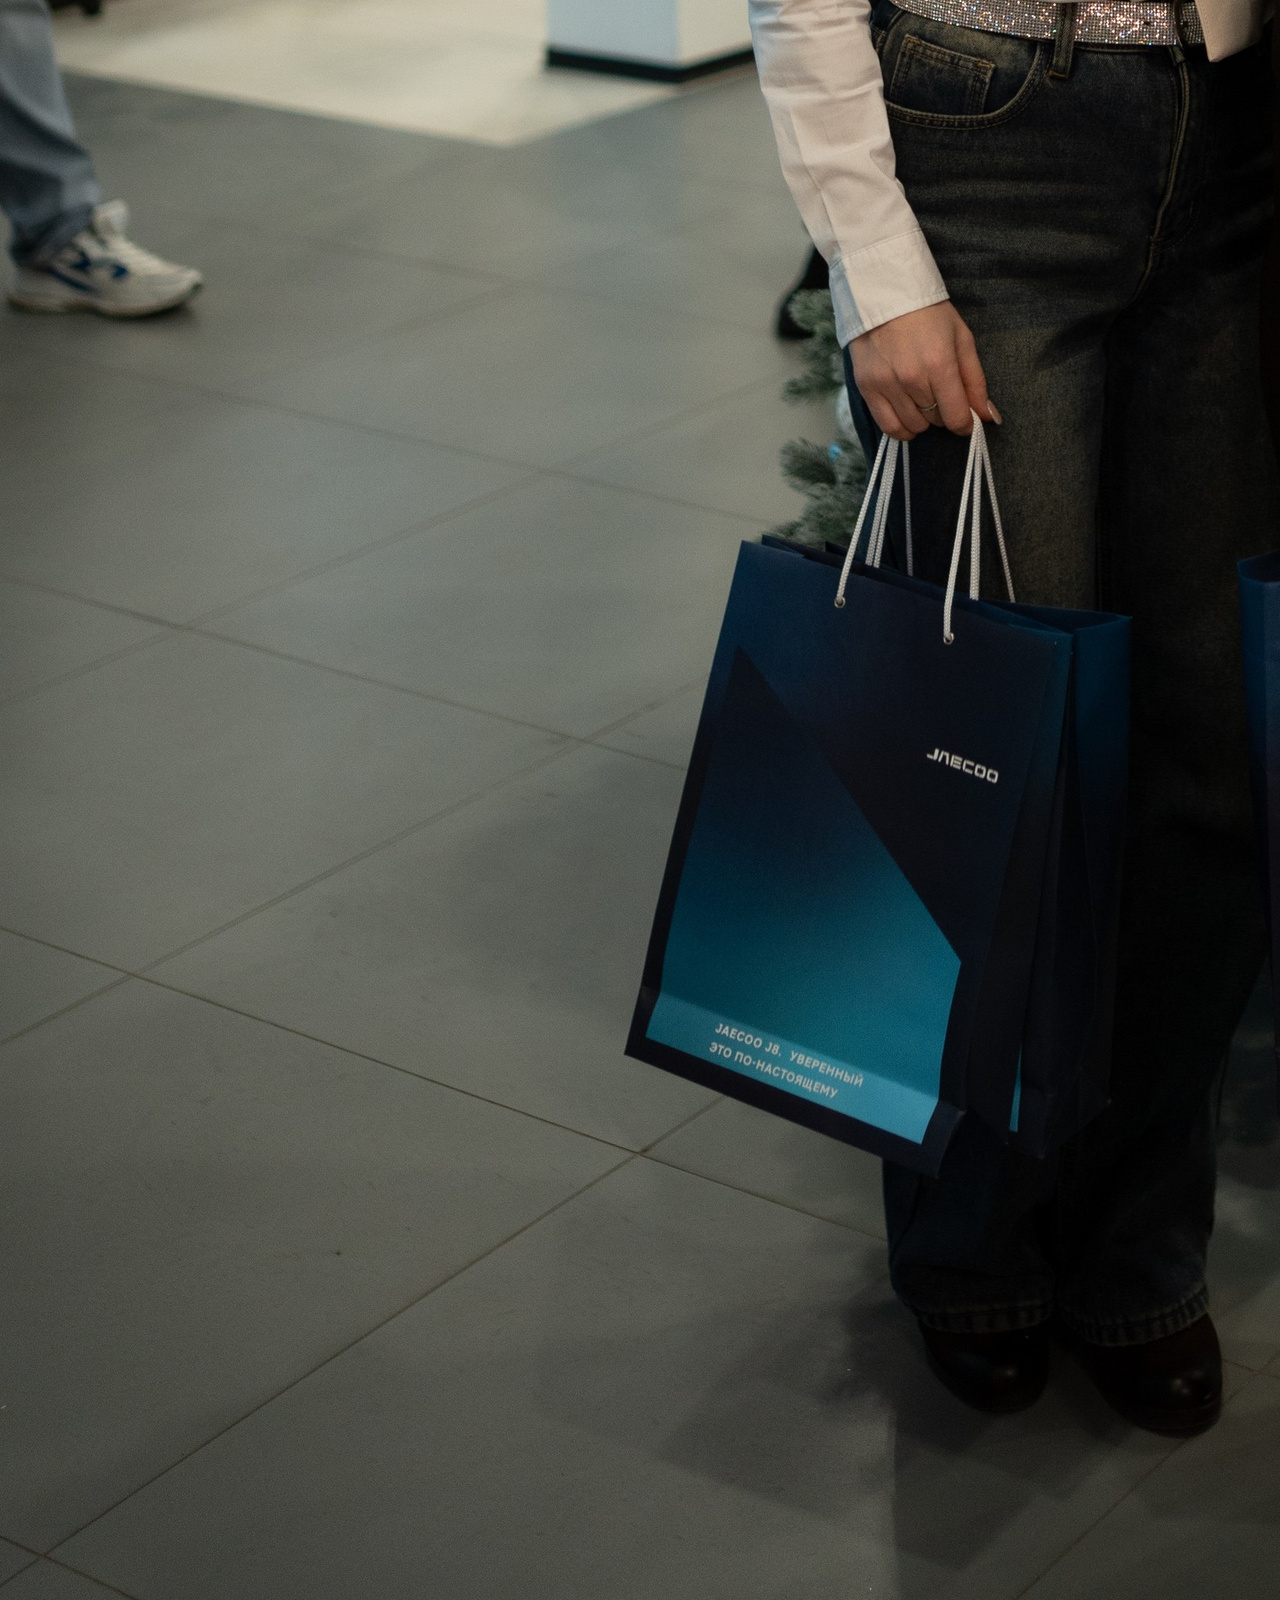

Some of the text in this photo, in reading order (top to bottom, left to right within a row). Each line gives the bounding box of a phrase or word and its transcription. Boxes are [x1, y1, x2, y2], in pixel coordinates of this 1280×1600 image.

[926, 748, 999, 784] JAECOO
[709, 1042, 838, 1098] ЭТО ПО-НАСТОЯЩЕМУ
[715, 1023, 763, 1049] JAECOO
[790, 1051, 864, 1087] УВЕРЕННЫЙ
